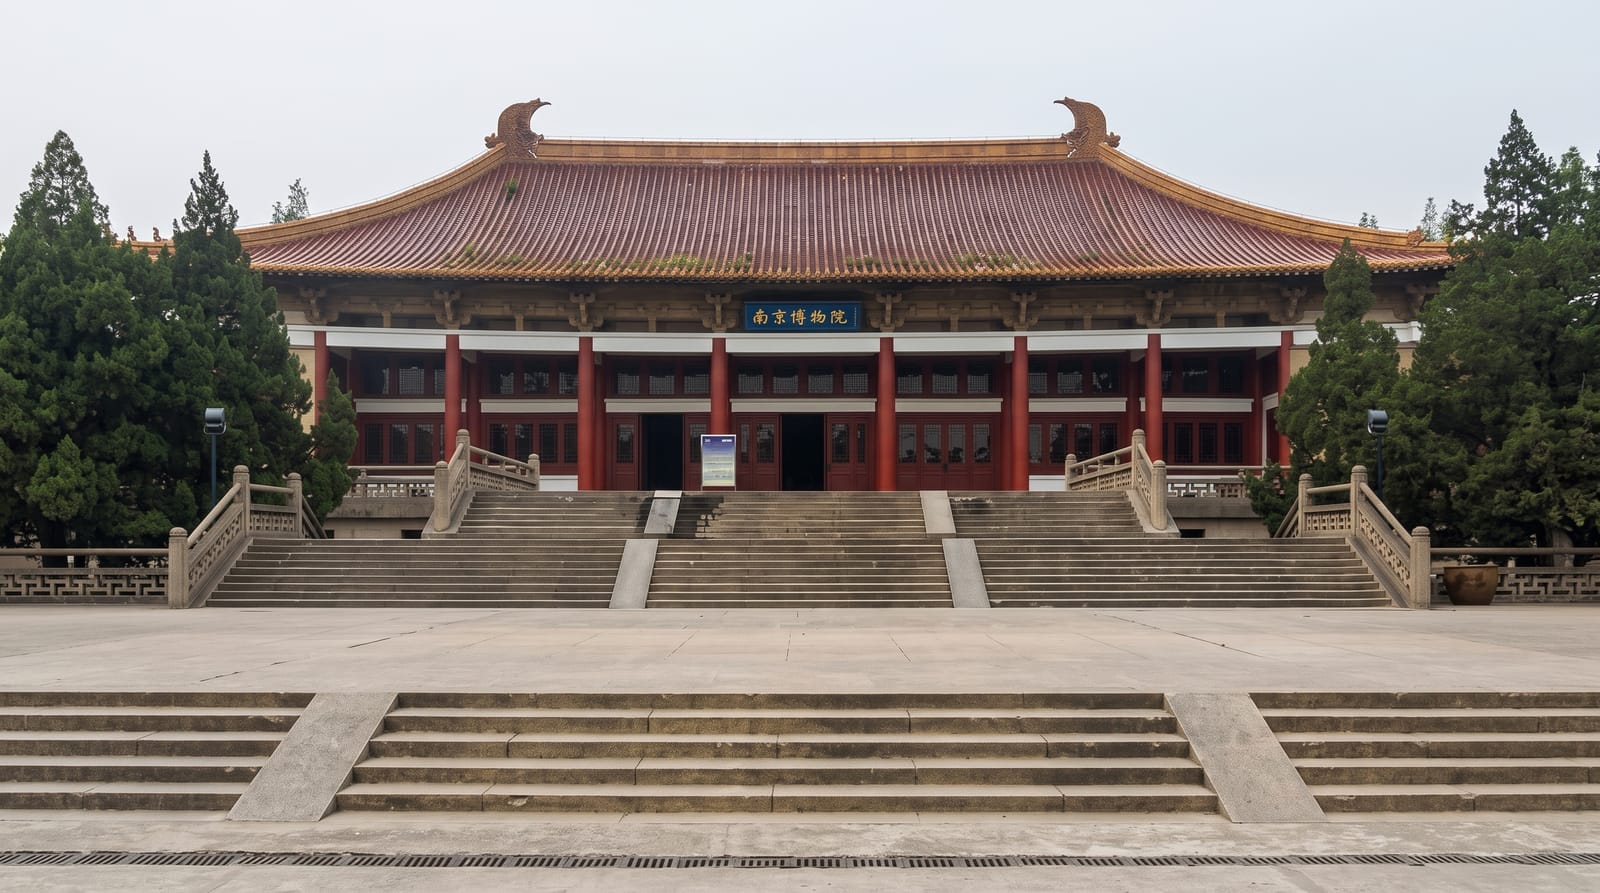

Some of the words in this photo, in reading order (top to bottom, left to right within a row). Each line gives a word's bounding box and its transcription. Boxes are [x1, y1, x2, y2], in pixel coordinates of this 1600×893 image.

[752, 308, 848, 326] 南京博物院
